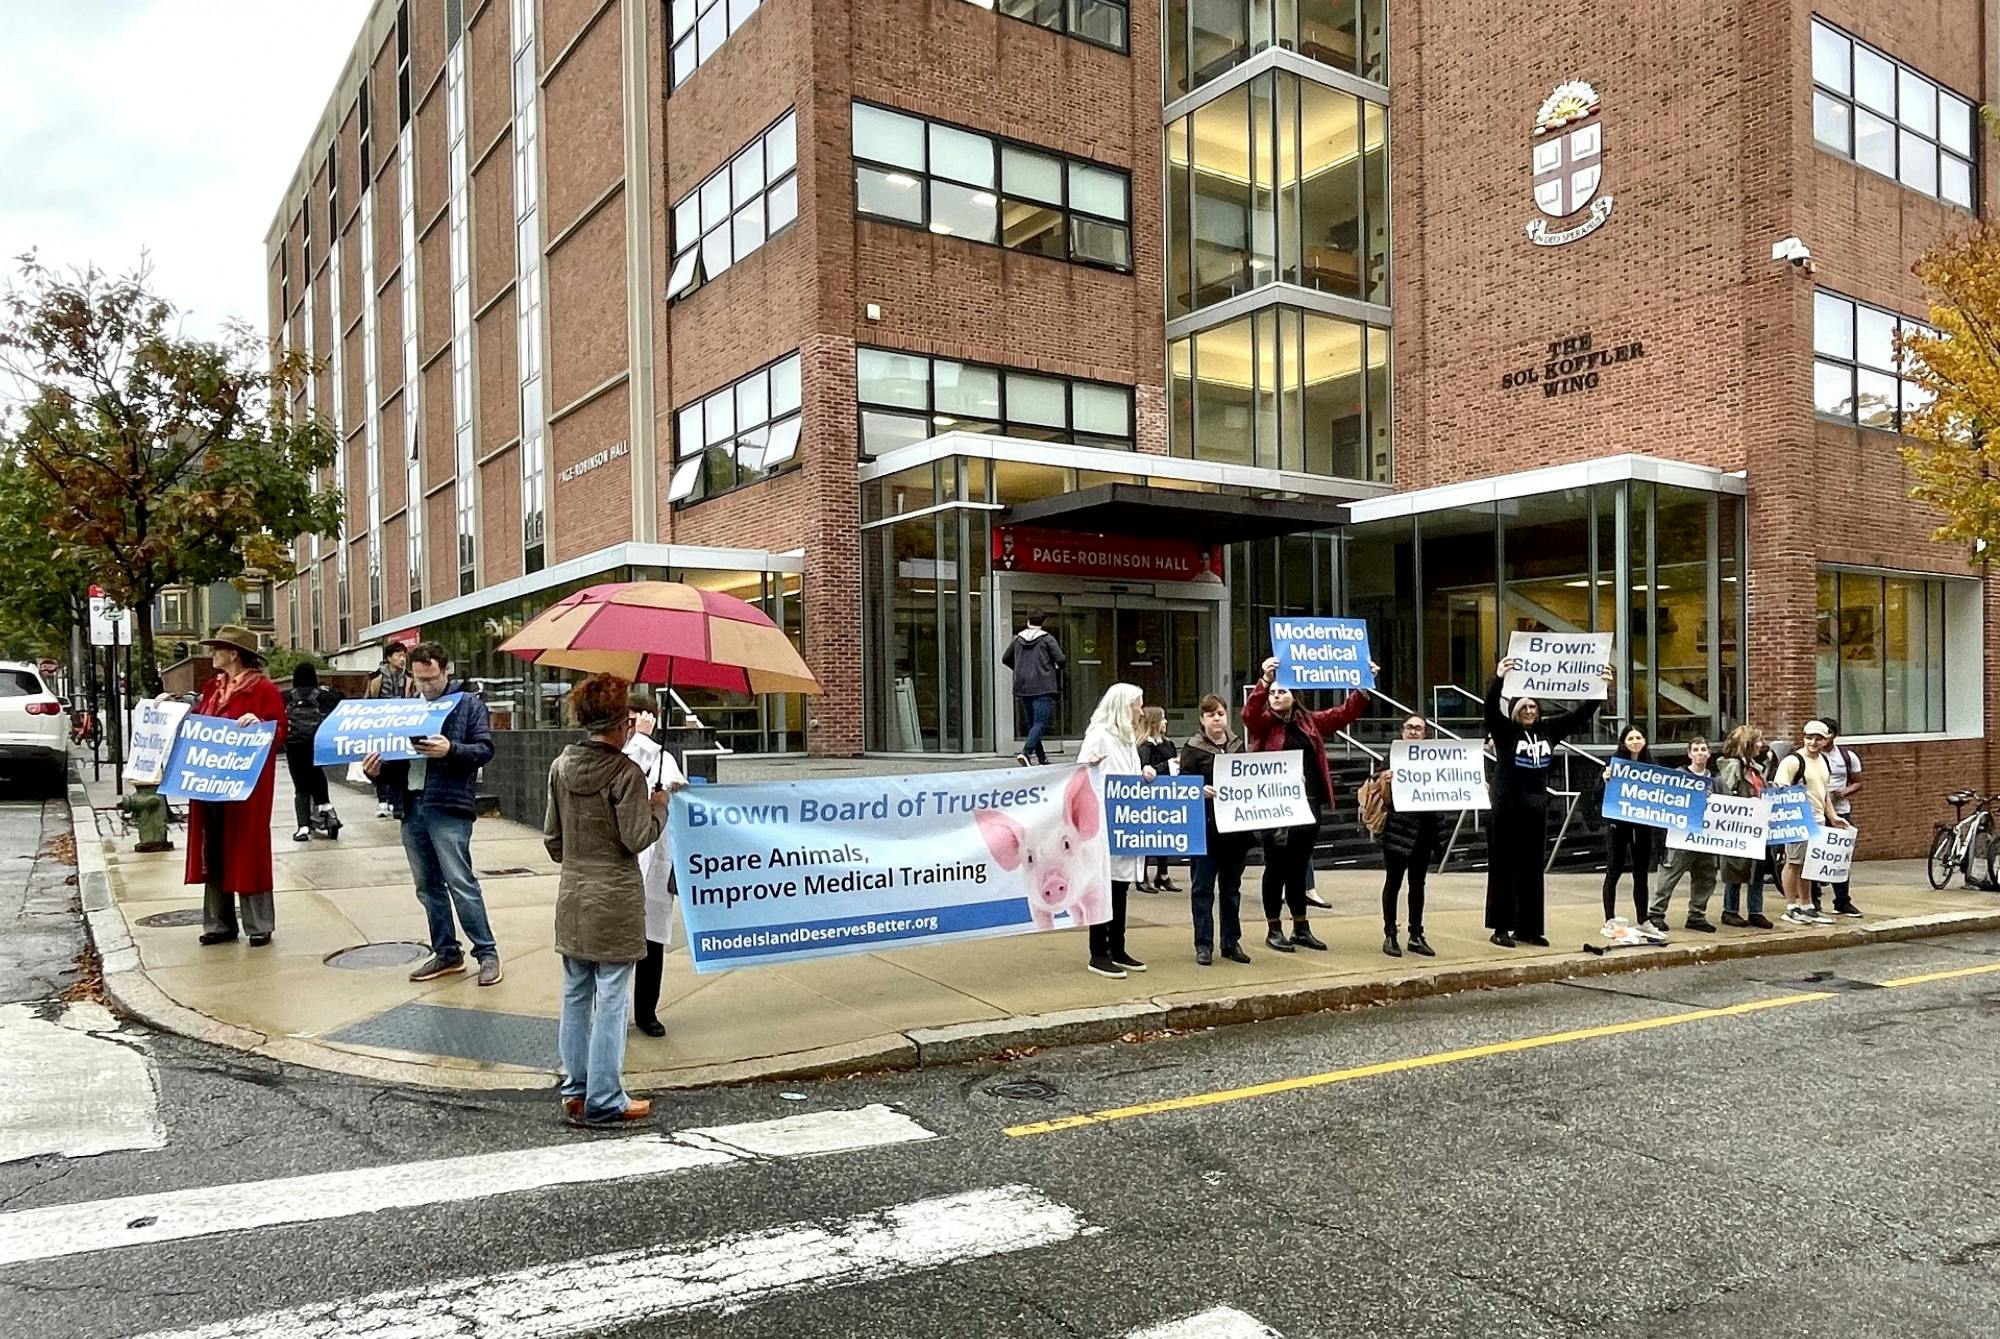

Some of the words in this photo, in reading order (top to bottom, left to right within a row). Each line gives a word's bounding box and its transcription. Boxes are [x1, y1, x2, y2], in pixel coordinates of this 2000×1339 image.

[1546, 332, 1592, 362] THE
[1502, 368, 1539, 389] SOL
[1544, 342, 1645, 380] KOFFLER
[1543, 372, 1600, 398] WING
[1033, 548, 1150, 568] PAGE-ROBINSON
[1155, 556, 1189, 571] HALL
[1274, 622, 1364, 641] Modernize
[1290, 643, 1358, 661] Medical
[1529, 637, 1596, 654] Brown:
[1291, 665, 1361, 686] Training
[1512, 658, 1552, 676] Stop
[1557, 660, 1605, 677] Killing
[1523, 677, 1590, 692] Animals
[336, 701, 454, 717] Modernize
[338, 712, 430, 731] Medical
[180, 719, 272, 747] Modernize
[186, 746, 255, 771] Medical
[1408, 745, 1467, 761] Brown:
[1231, 759, 1288, 777] Brown:
[1396, 768, 1432, 786] Stop
[1436, 768, 1482, 785] Killing
[1612, 763, 1706, 791] Modernize
[180, 771, 245, 798] Training
[1107, 781, 1200, 800] Modernize
[1219, 785, 1253, 803] Stop
[1257, 783, 1301, 800] Killing
[1412, 787, 1471, 803] Animals
[1620, 783, 1691, 808] Medical
[688, 802, 789, 827] Brown
[800, 794, 888, 823] Board
[897, 792, 927, 818] of
[932, 785, 1050, 815] Trustees:
[1115, 805, 1187, 824] Medical
[1234, 804, 1294, 822] Animals
[1619, 801, 1688, 829] Training
[1707, 802, 1753, 817] own:
[1715, 819, 1763, 838] Killing
[1769, 824, 1809, 840] raining
[1114, 829, 1188, 852] Training
[1685, 832, 1747, 850] Animals
[689, 850, 762, 879] Spare
[768, 844, 870, 869] Animals,
[1811, 848, 1842, 864] Stop
[691, 878, 797, 908] Improve
[804, 867, 893, 895] Medical
[899, 860, 988, 887] Training
[701, 915, 938, 952] RhodeIslandDeservesBetter.org
